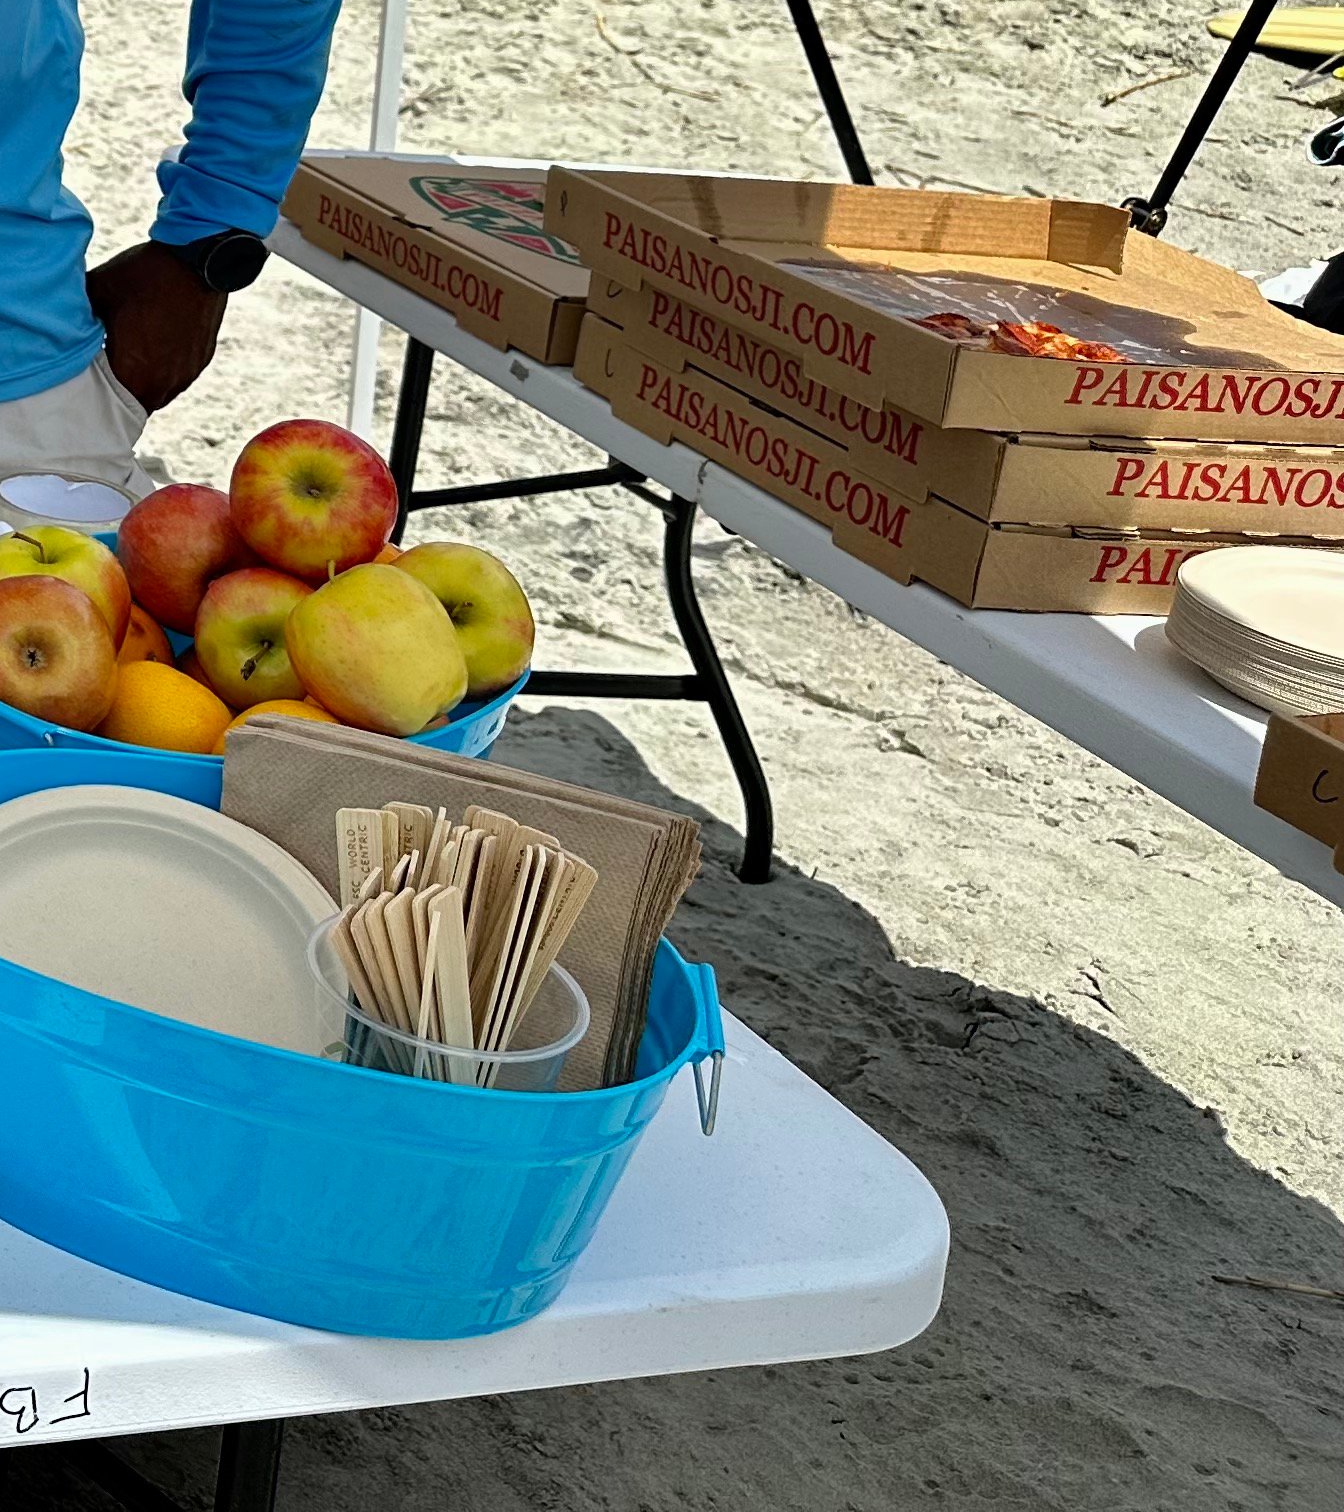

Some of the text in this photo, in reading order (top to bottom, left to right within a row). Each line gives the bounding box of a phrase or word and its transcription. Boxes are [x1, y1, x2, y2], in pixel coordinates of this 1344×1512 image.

[317, 194, 505, 322] PAISANOSJI.COM
[603, 211, 876, 376] PAISANOSJI.COM
[1064, 367, 1344, 419] PAISANOSJ
[636, 364, 911, 549] PAISANOSJI.COM
[346, 828, 357, 868] WORLD
[358, 824, 370, 874] CENTRIC
[403, 824, 413, 855] TRIC
[0, 1366, 91, 1434] FB
